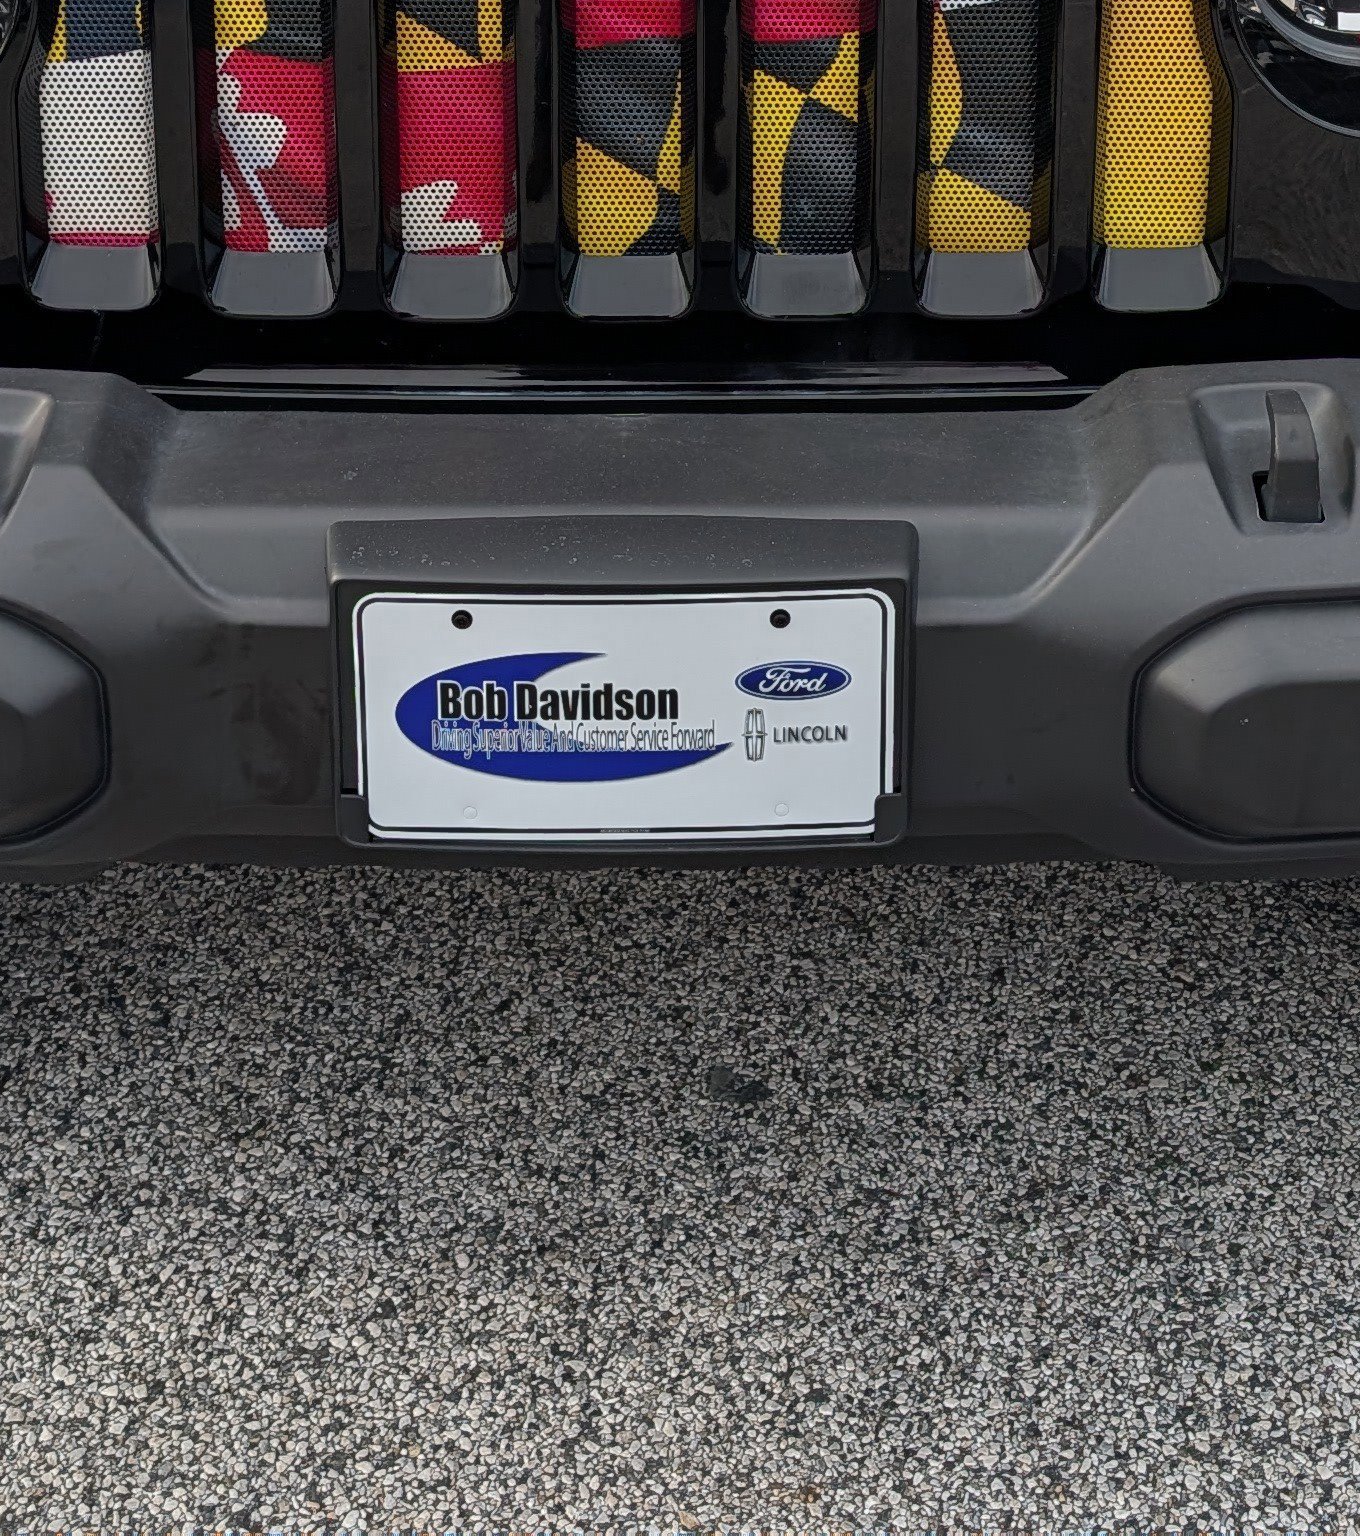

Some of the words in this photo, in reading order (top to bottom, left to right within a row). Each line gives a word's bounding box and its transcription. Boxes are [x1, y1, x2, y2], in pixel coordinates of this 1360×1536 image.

[758, 667, 829, 694] Ford
[436, 679, 507, 722] Bob
[515, 682, 680, 722] Davidson
[431, 720, 473, 759] Driving
[473, 721, 520, 760] Superior
[519, 720, 551, 752] Value
[551, 721, 575, 752] And
[575, 721, 629, 752] Customer
[630, 721, 670, 752] Service
[670, 719, 717, 751] Forward
[772, 724, 848, 745] LINCOLN
